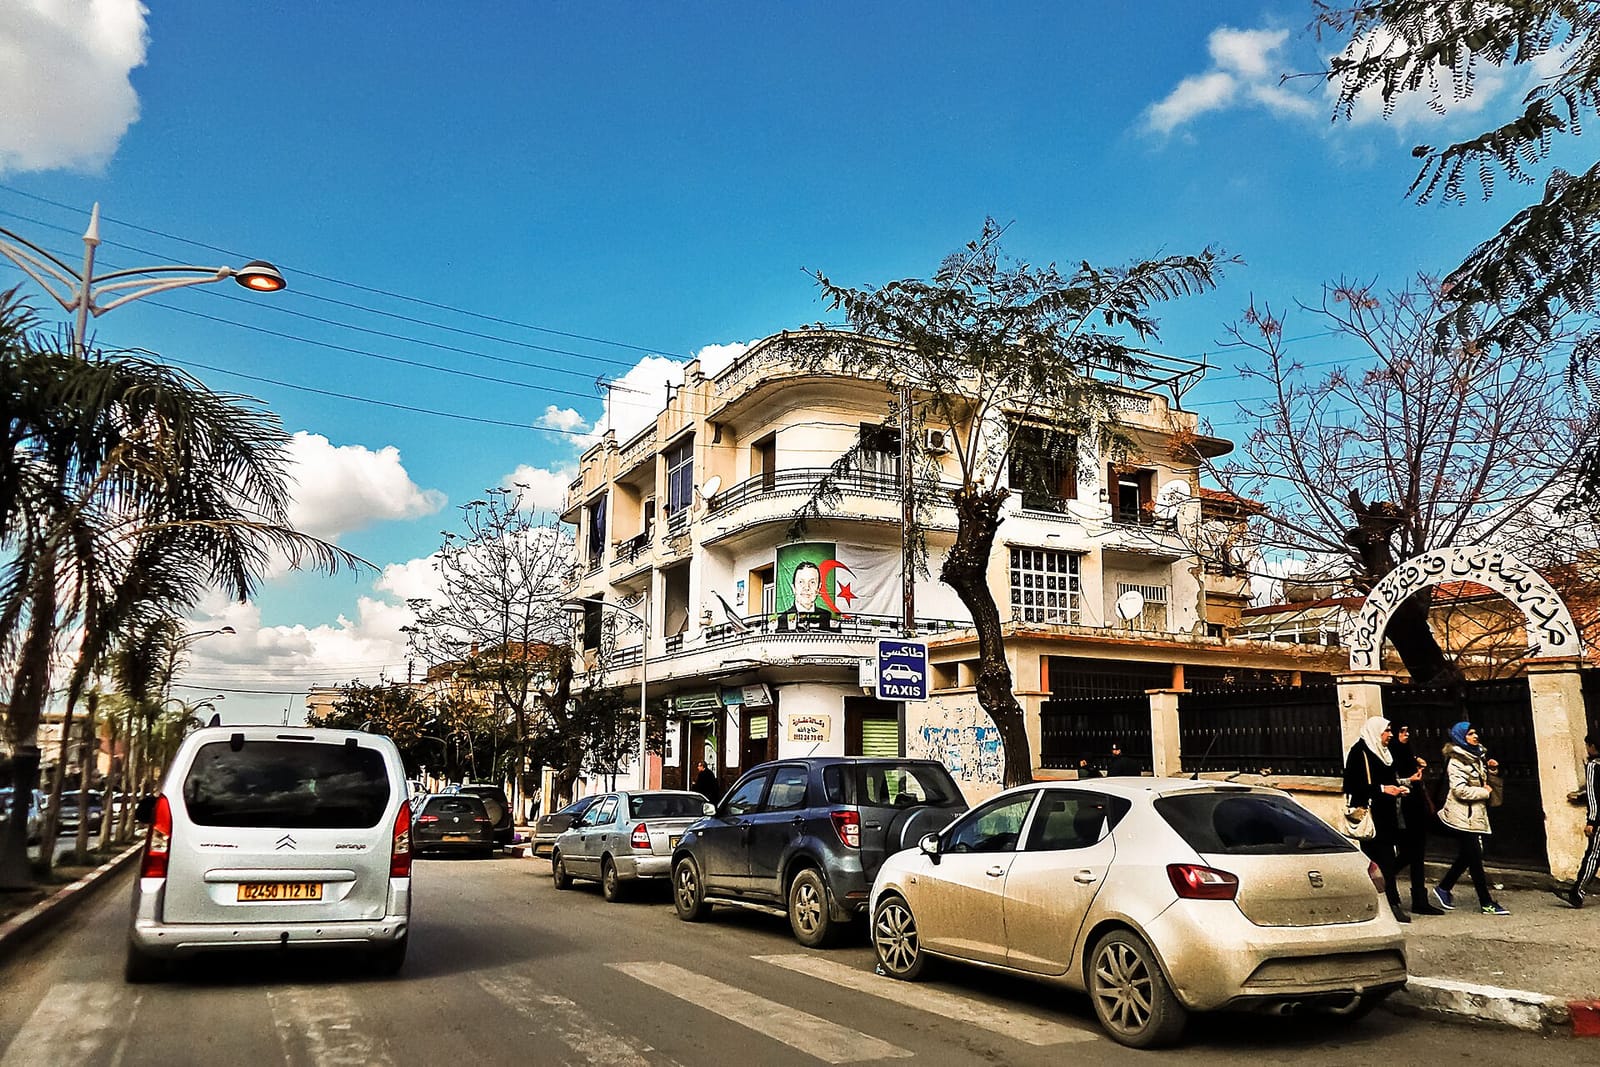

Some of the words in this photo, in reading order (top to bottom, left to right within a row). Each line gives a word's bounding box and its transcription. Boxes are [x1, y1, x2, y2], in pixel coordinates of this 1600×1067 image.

[1451, 549, 1487, 579] بن
[1488, 553, 1571, 647] مدرسة
[881, 646, 924, 661] طاكسي
[883, 684, 921, 697] TAXIS
[244, 884, 278, 898] 02450
[282, 884, 301, 898] 112
[305, 884, 317, 897] 16
